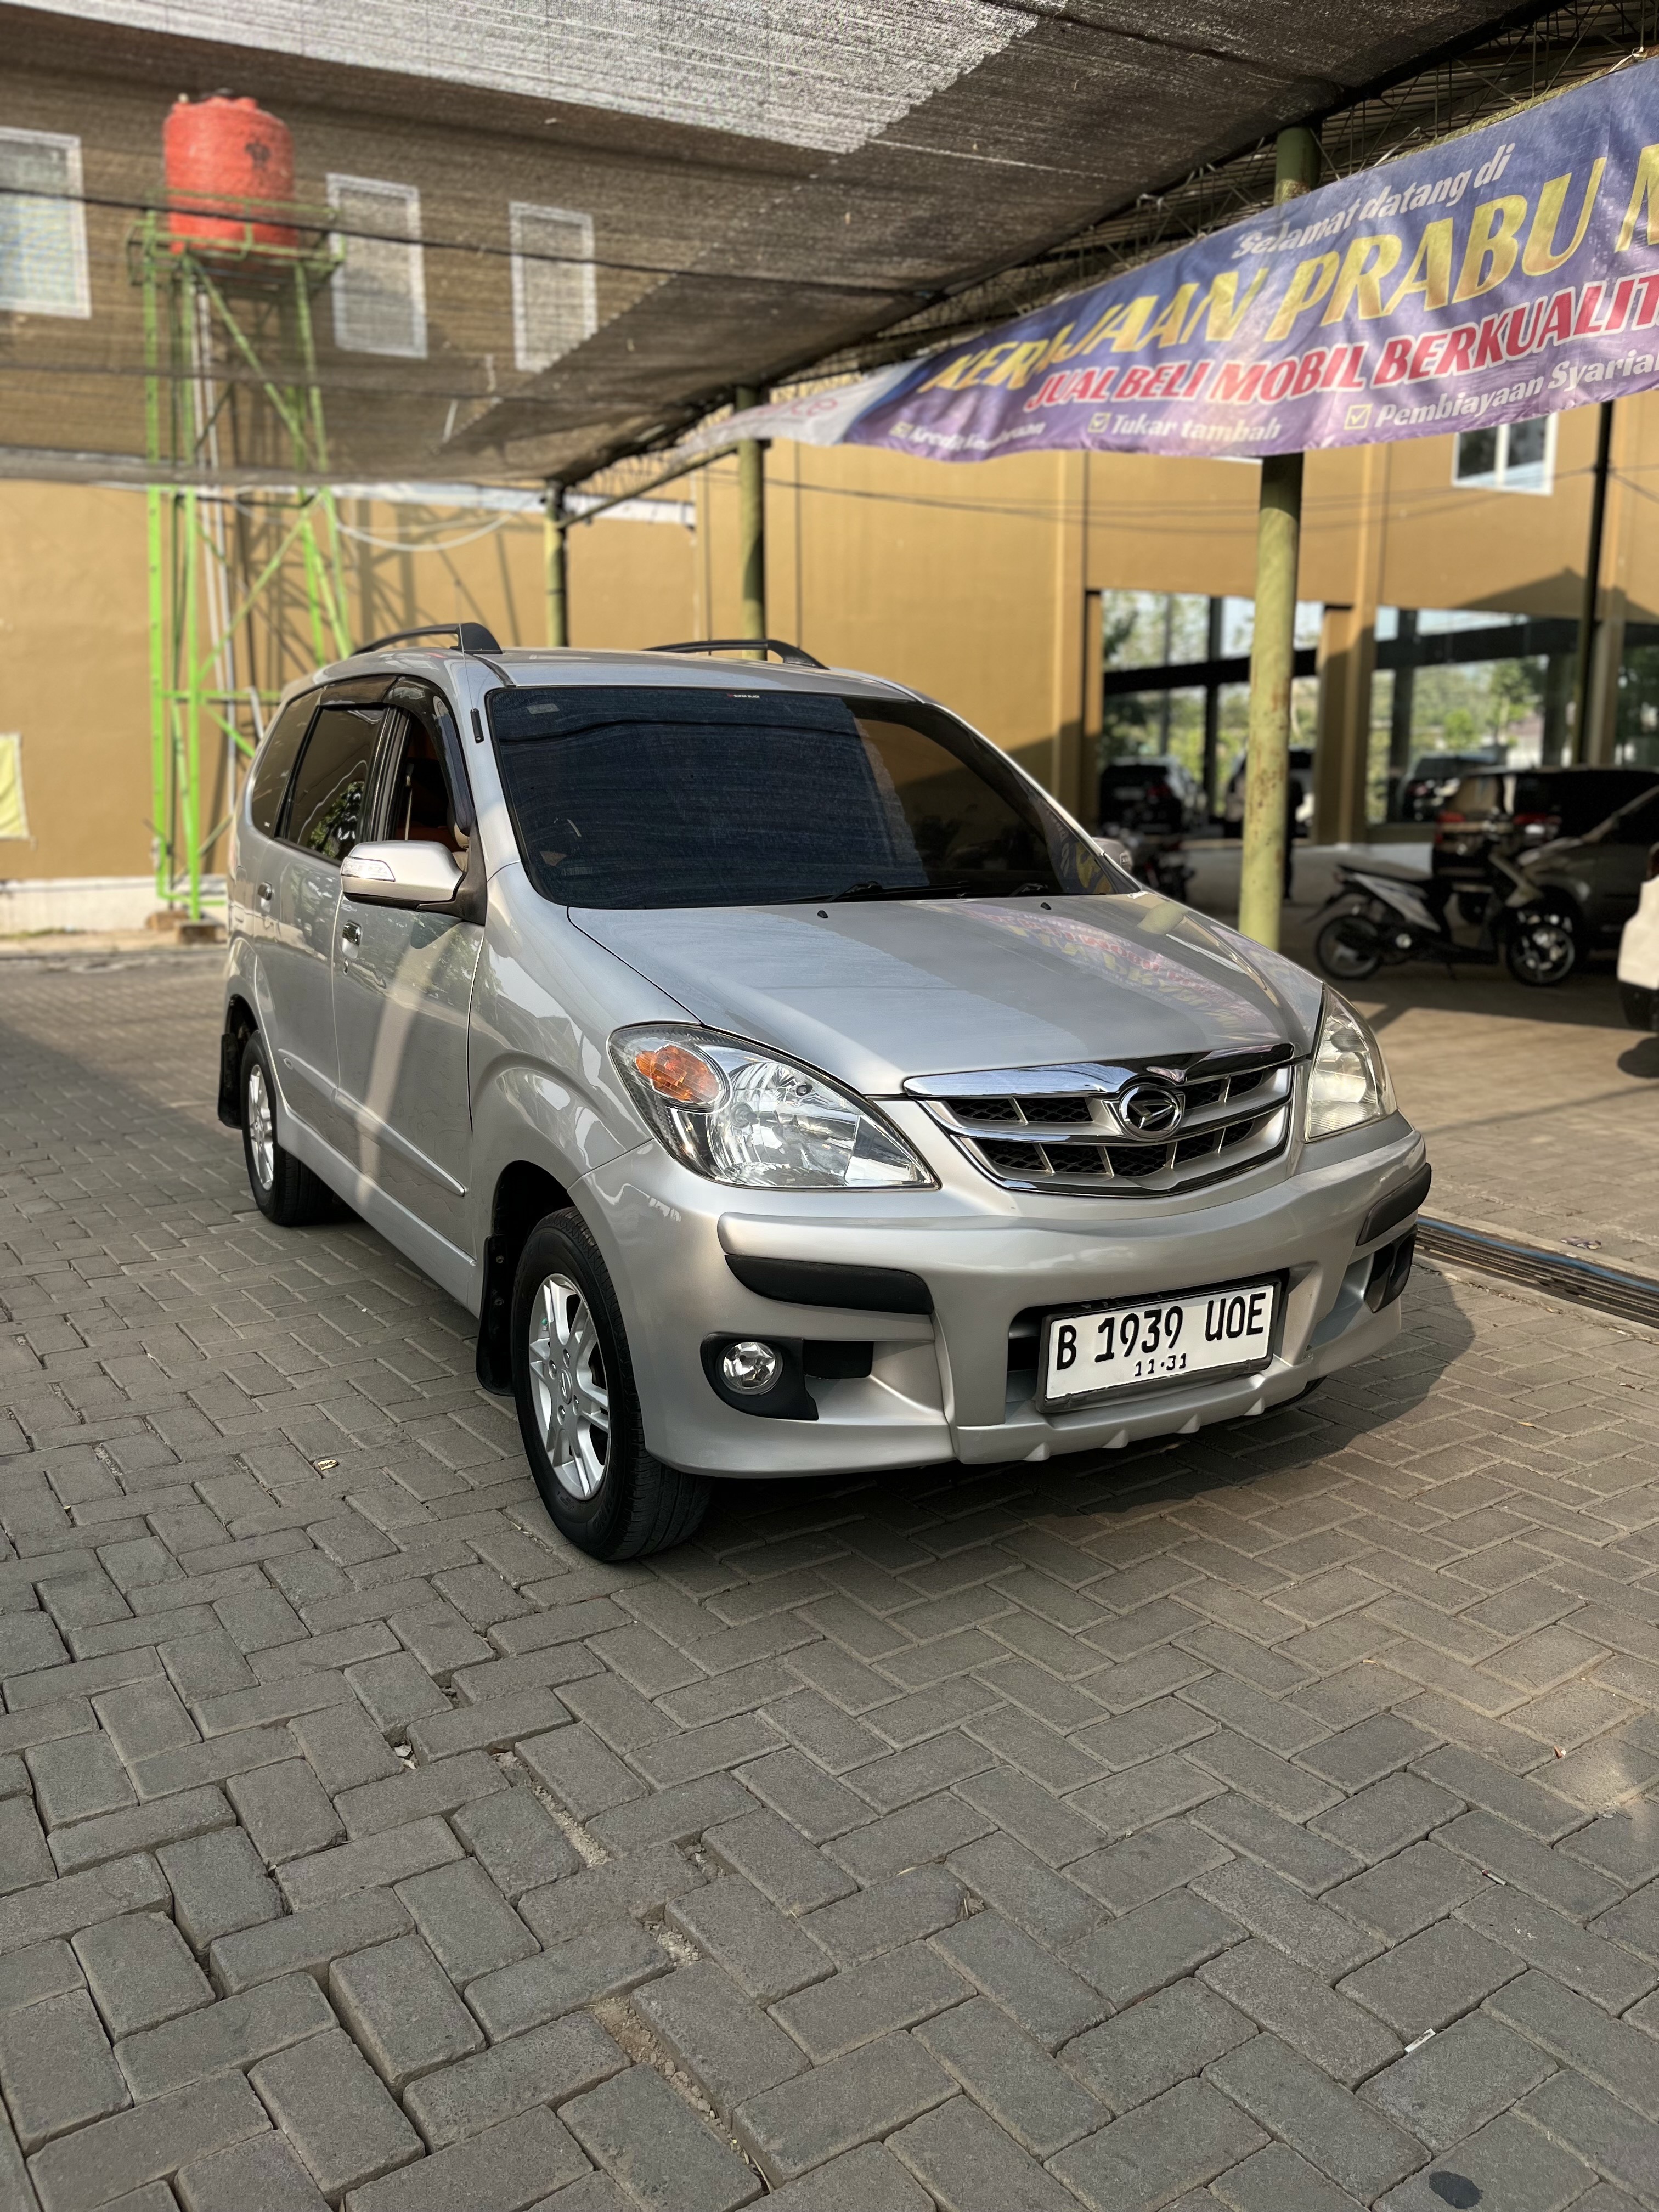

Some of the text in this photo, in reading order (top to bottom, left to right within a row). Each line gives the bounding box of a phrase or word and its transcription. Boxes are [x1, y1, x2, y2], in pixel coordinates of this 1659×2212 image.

[1232, 143, 1515, 259] Selamat datang di
[1263, 157, 1607, 343] PRABU
[1024, 365, 1120, 413] JUAL
[1111, 360, 1211, 402] BELI
[1207, 344, 1368, 404] MOBIL
[1375, 349, 1659, 428] Pembiayaan Syaria
[1111, 413, 1282, 443] Tukar tambah
[1056, 1293, 1266, 1370] B 1939 UOE
